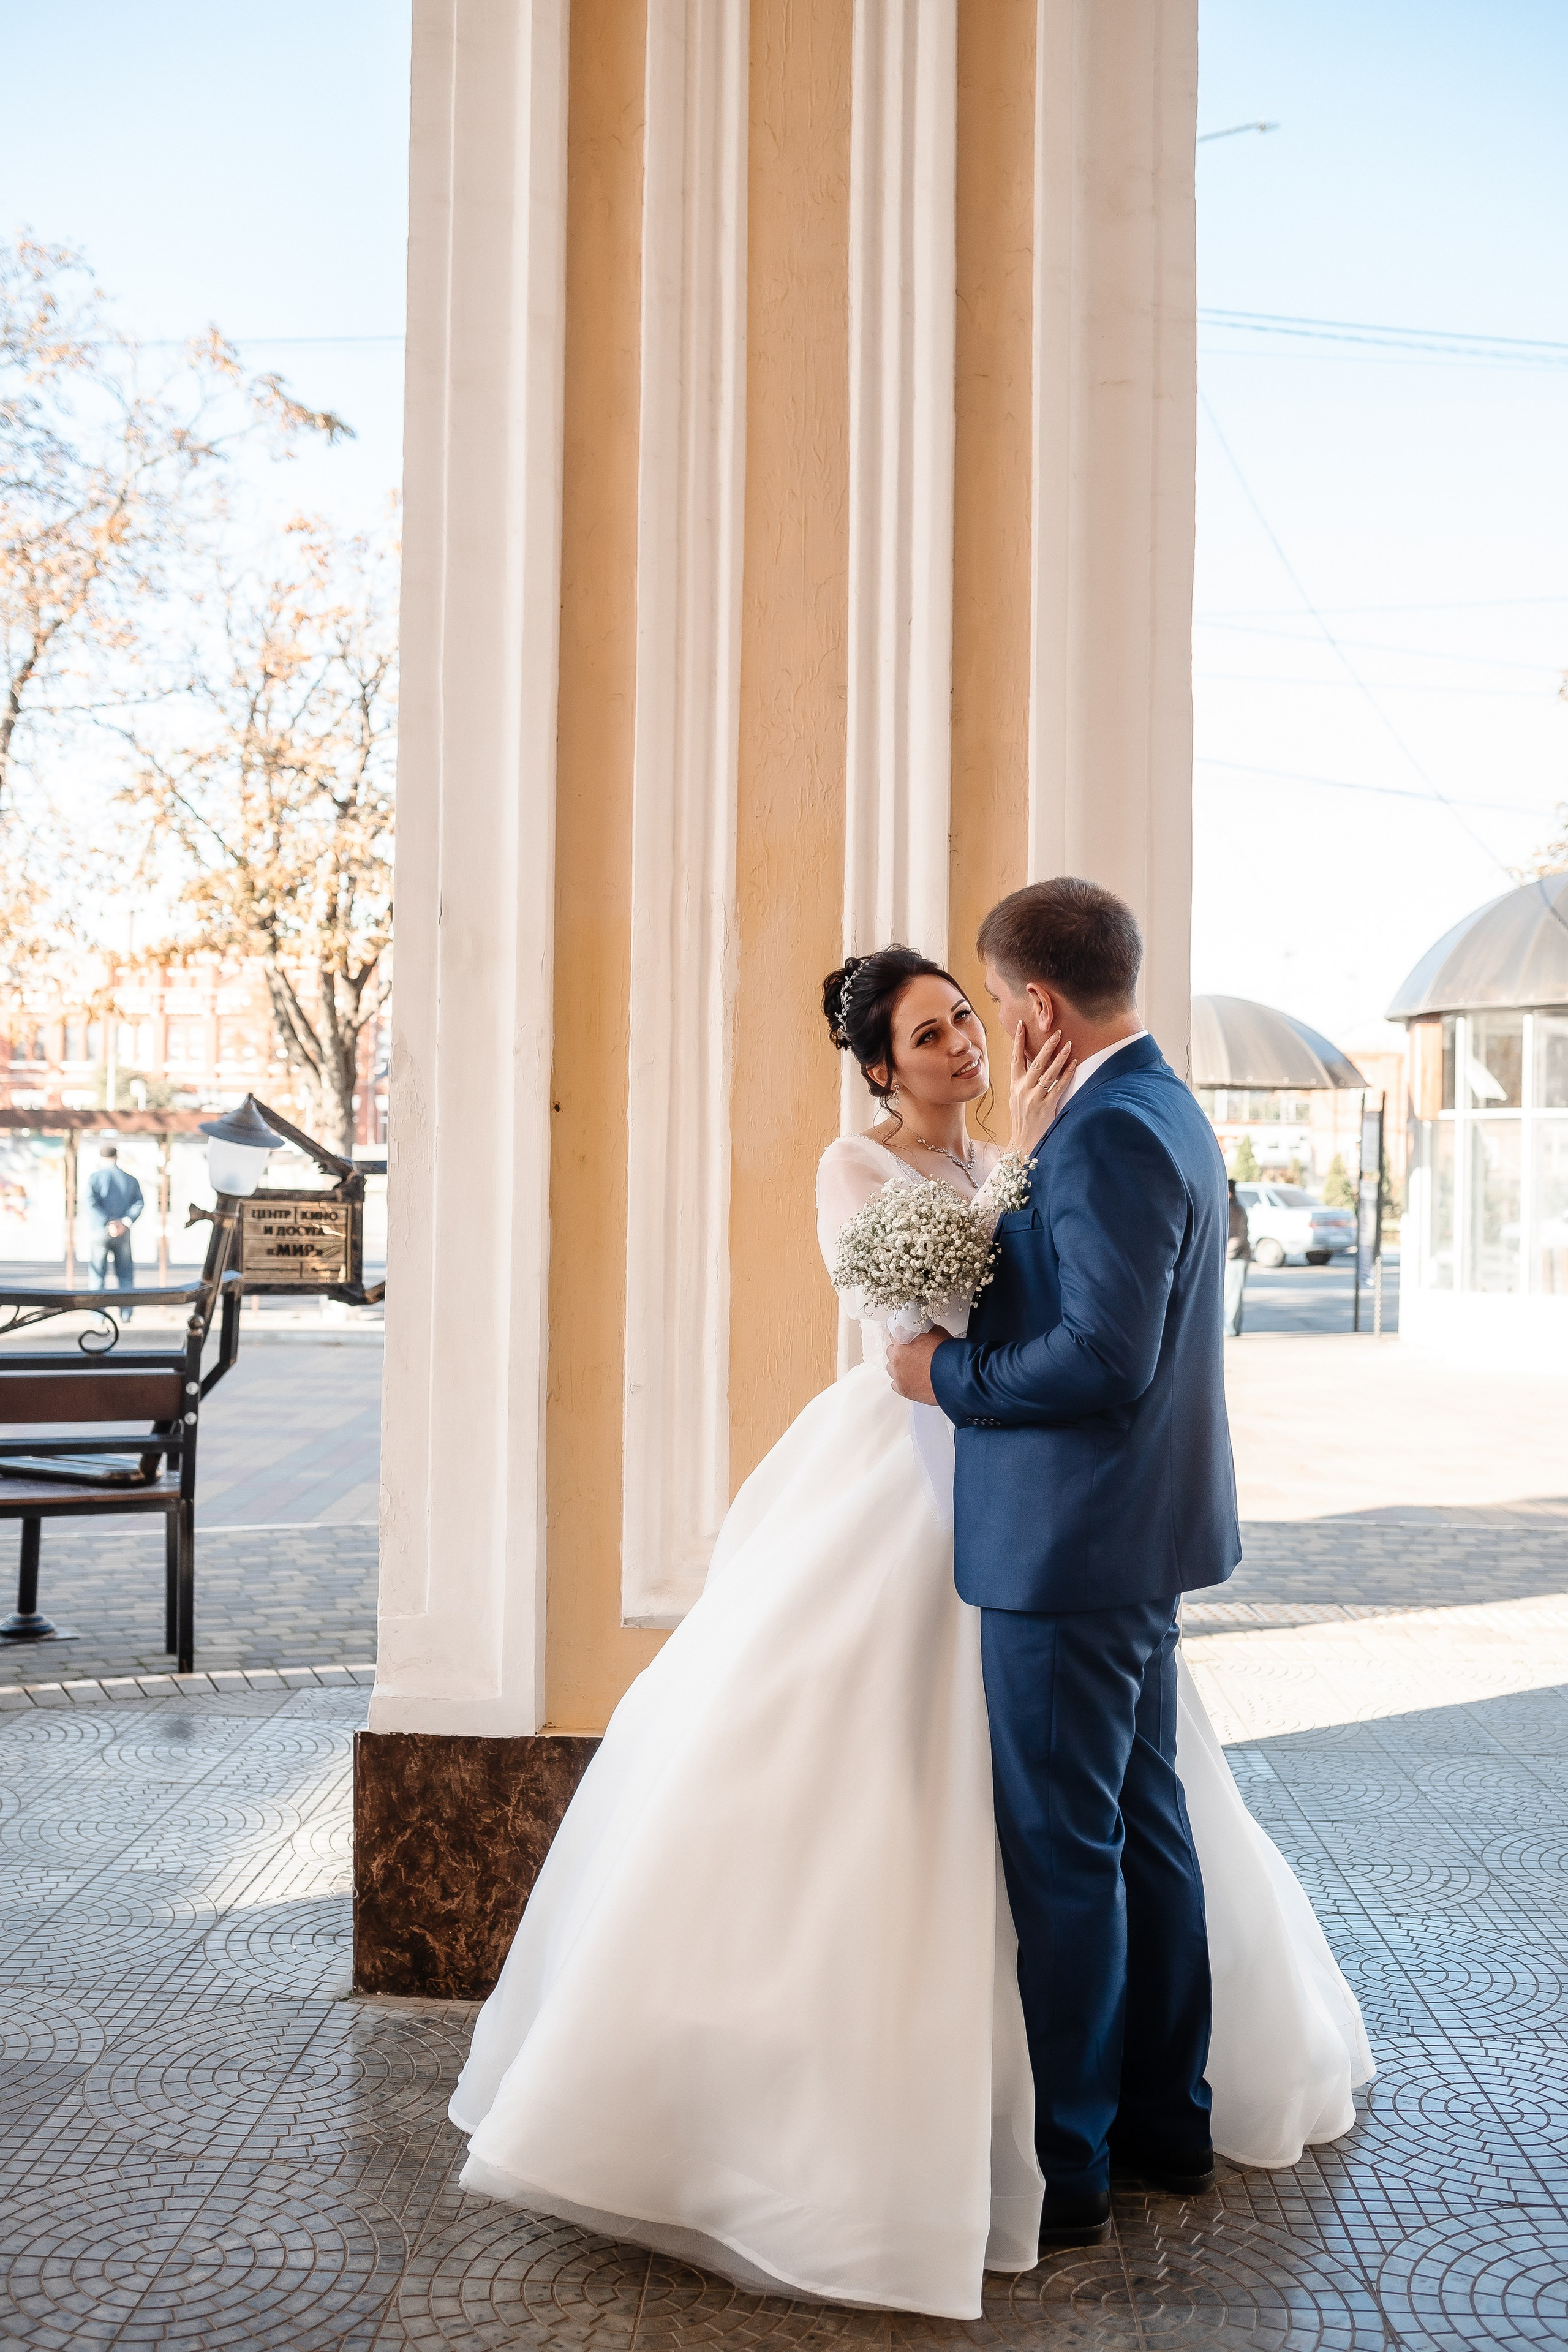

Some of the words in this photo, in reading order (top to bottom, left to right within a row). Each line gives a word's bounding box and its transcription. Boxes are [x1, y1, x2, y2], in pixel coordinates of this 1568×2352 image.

[252, 1209, 291, 1219] ЦЕНТР
[301, 1211, 338, 1220] КИНО
[263, 1226, 273, 1234] И
